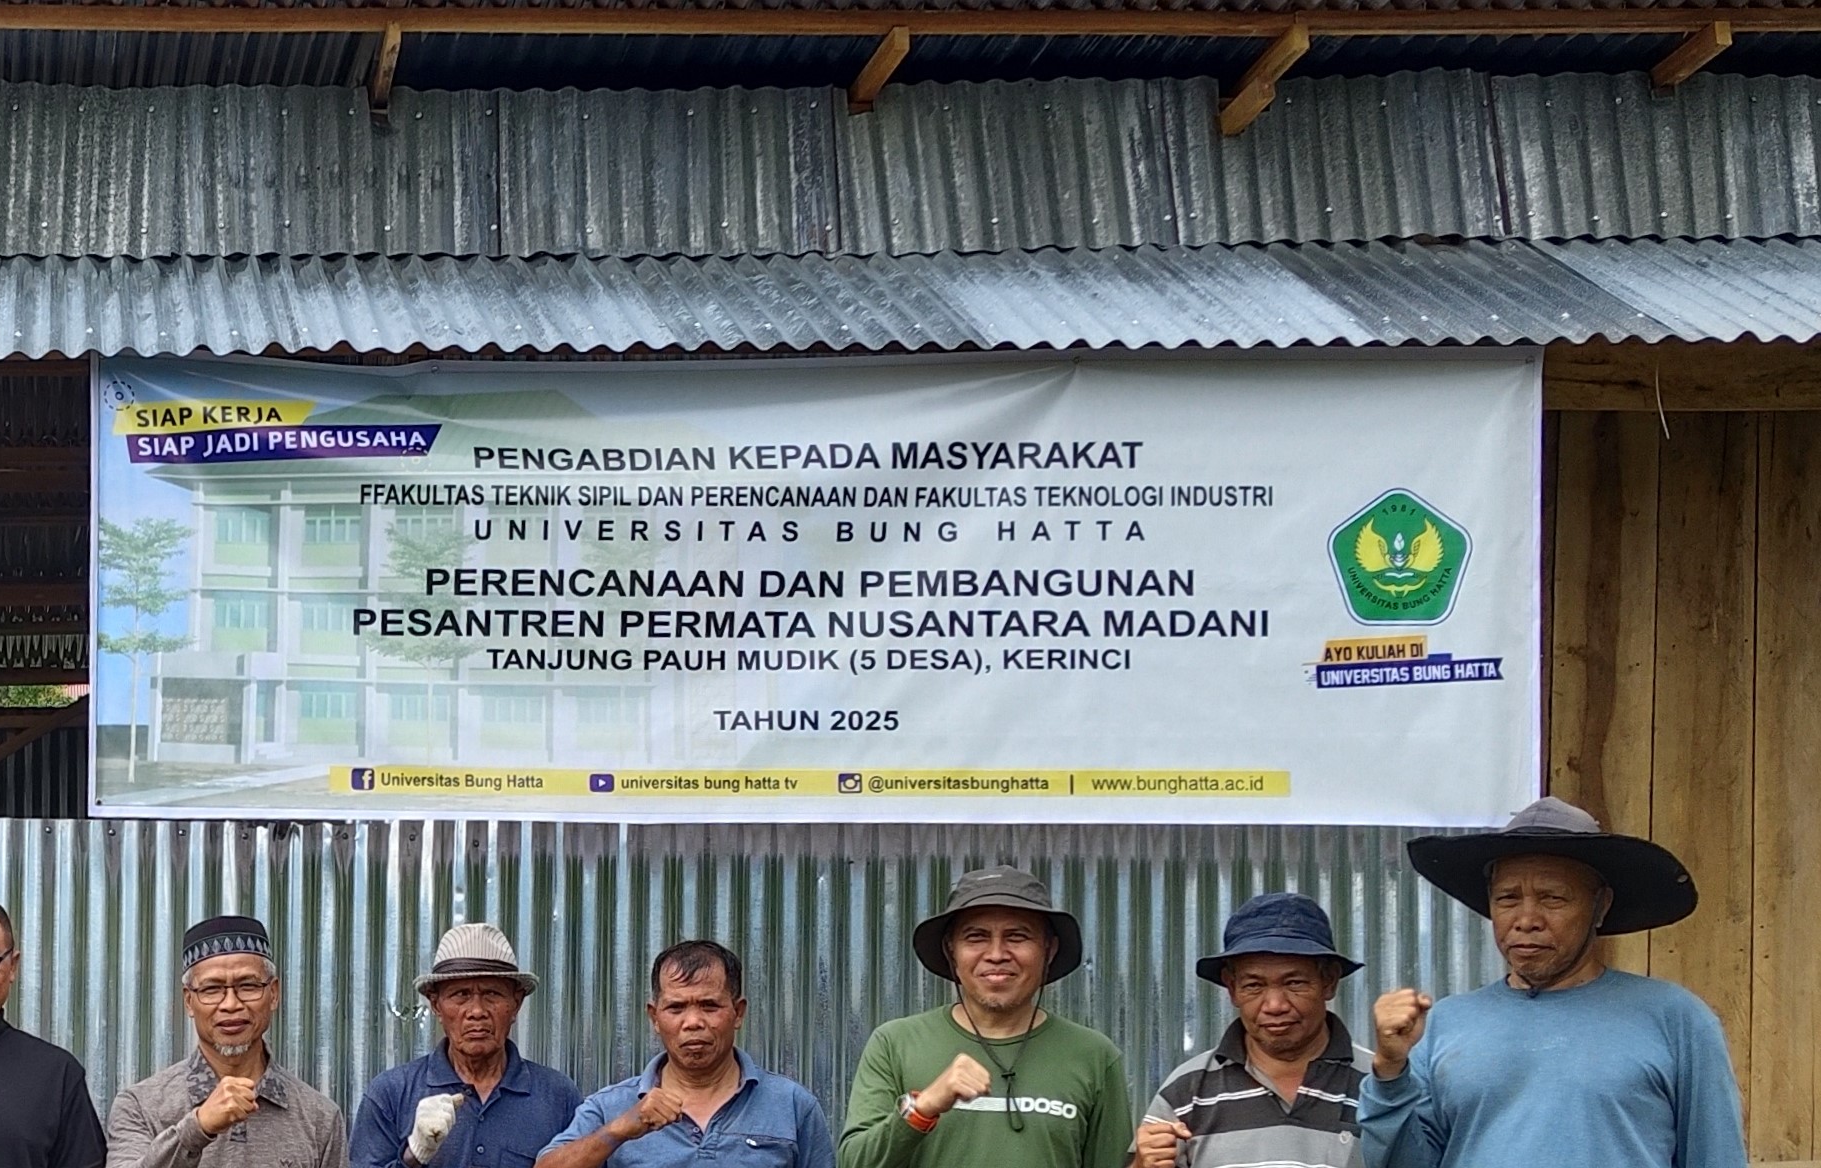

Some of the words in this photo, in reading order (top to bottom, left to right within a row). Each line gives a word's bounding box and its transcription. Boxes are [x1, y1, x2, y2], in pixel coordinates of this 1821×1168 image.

[136, 408, 193, 428] SIAP
[202, 405, 283, 425] KERJA
[137, 434, 195, 458] SIAP
[203, 433, 259, 458] JADI
[268, 430, 427, 451] PENGUSAHA
[473, 446, 716, 472] PENGABDIAN
[728, 442, 881, 471] KEPADA
[891, 441, 1144, 471] MASYARAKAT
[359, 484, 485, 507] FFAKULTAS
[491, 484, 572, 507] TEKNIK
[577, 485, 632, 507] SIPIL
[637, 486, 684, 507] DAN
[690, 485, 857, 508] PERENCANAAN
[863, 486, 909, 508] DAN
[914, 485, 1027, 509] FAKULTAS
[1033, 485, 1164, 508] TEKNOLOGI
[1170, 485, 1273, 507] INDUSTRI
[1382, 504, 1416, 516] 1981
[474, 519, 799, 543] UNIVERSITAS
[835, 521, 959, 543] BUNG
[997, 520, 1146, 542] HATTA
[425, 568, 744, 598] PERENCANAAN
[759, 570, 844, 599] DAN
[860, 568, 1195, 598] PEMBANGUNAN
[1348, 567, 1399, 610] UNIVERSITAS
[1402, 594, 1431, 610] BUNG
[1430, 567, 1452, 596] HATTA
[352, 608, 605, 638] PESANTREN
[620, 610, 817, 639] PERMATA
[828, 609, 1092, 639] NUSANTARA
[1103, 609, 1269, 638] MADANI
[485, 648, 633, 671] TANJUNG
[643, 649, 726, 672] PAUH
[737, 649, 840, 671] MUDIK
[849, 648, 877, 676] (5
[886, 648, 992, 676] DESA),
[1002, 648, 1131, 671] KERINCI
[1324, 645, 1352, 662] AYO
[1357, 643, 1405, 660] KULIAH
[1410, 642, 1424, 657] DI
[1320, 666, 1410, 686] UNIVERSITAS
[1413, 664, 1451, 681] BUNG
[1454, 661, 1498, 678] HATTA
[712, 709, 820, 732] TAHUN
[829, 710, 900, 732] 2025
[380, 771, 461, 789] Universitas
[464, 773, 503, 792] Bung
[506, 773, 544, 789] Hatta
[620, 774, 700, 791] universitas
[703, 775, 741, 794] bung
[744, 775, 781, 791] hatta
[783, 776, 799, 791] tv
[867, 774, 1050, 795] @universitasbunghatta
[1091, 774, 1264, 795] www.bunghatta.ac.id
